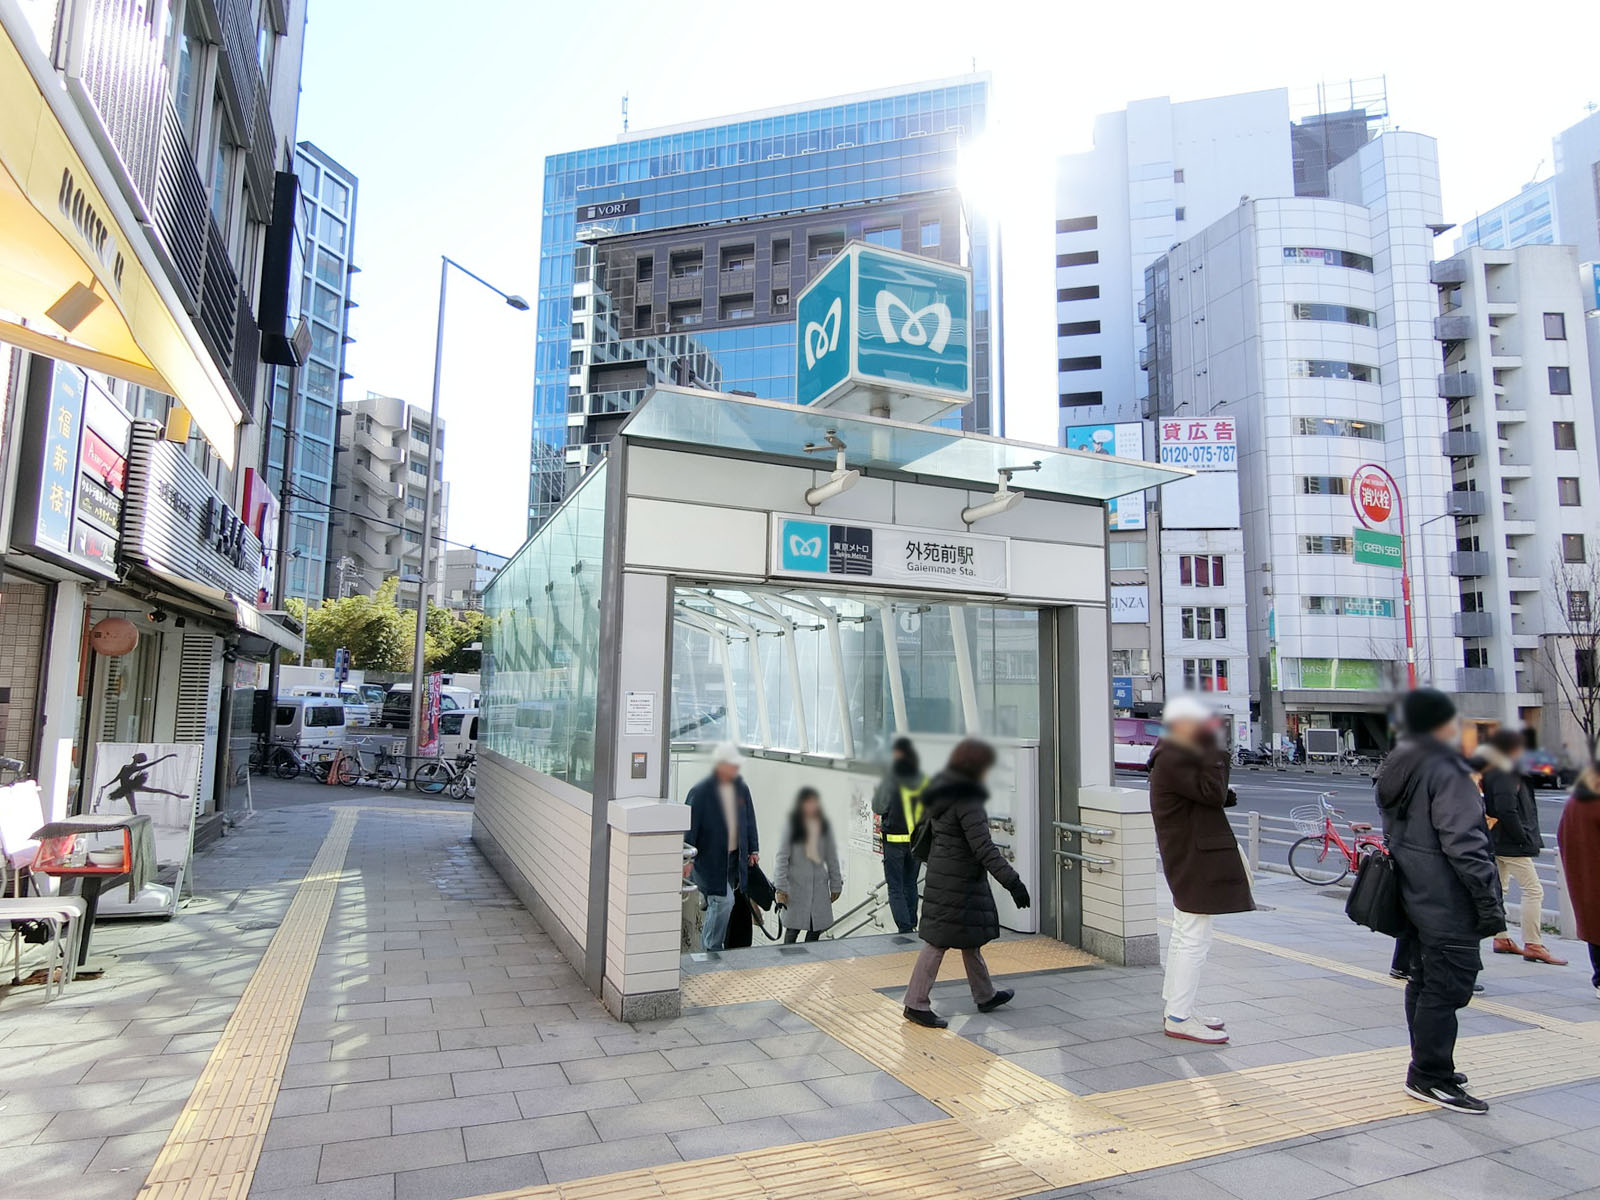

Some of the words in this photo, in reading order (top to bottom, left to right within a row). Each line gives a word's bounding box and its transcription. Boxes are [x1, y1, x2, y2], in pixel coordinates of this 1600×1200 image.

[598, 203, 628, 215] VORT
[1362, 486, 1390, 509] 消火栓
[833, 542, 869, 553] 東京メトロ
[906, 540, 973, 565] 外苑前駅
[1363, 543, 1384, 555] GREEN
[1384, 545, 1400, 557] SEED
[907, 562, 956, 574] Gaiemmae
[959, 566, 977, 576] Sta.
